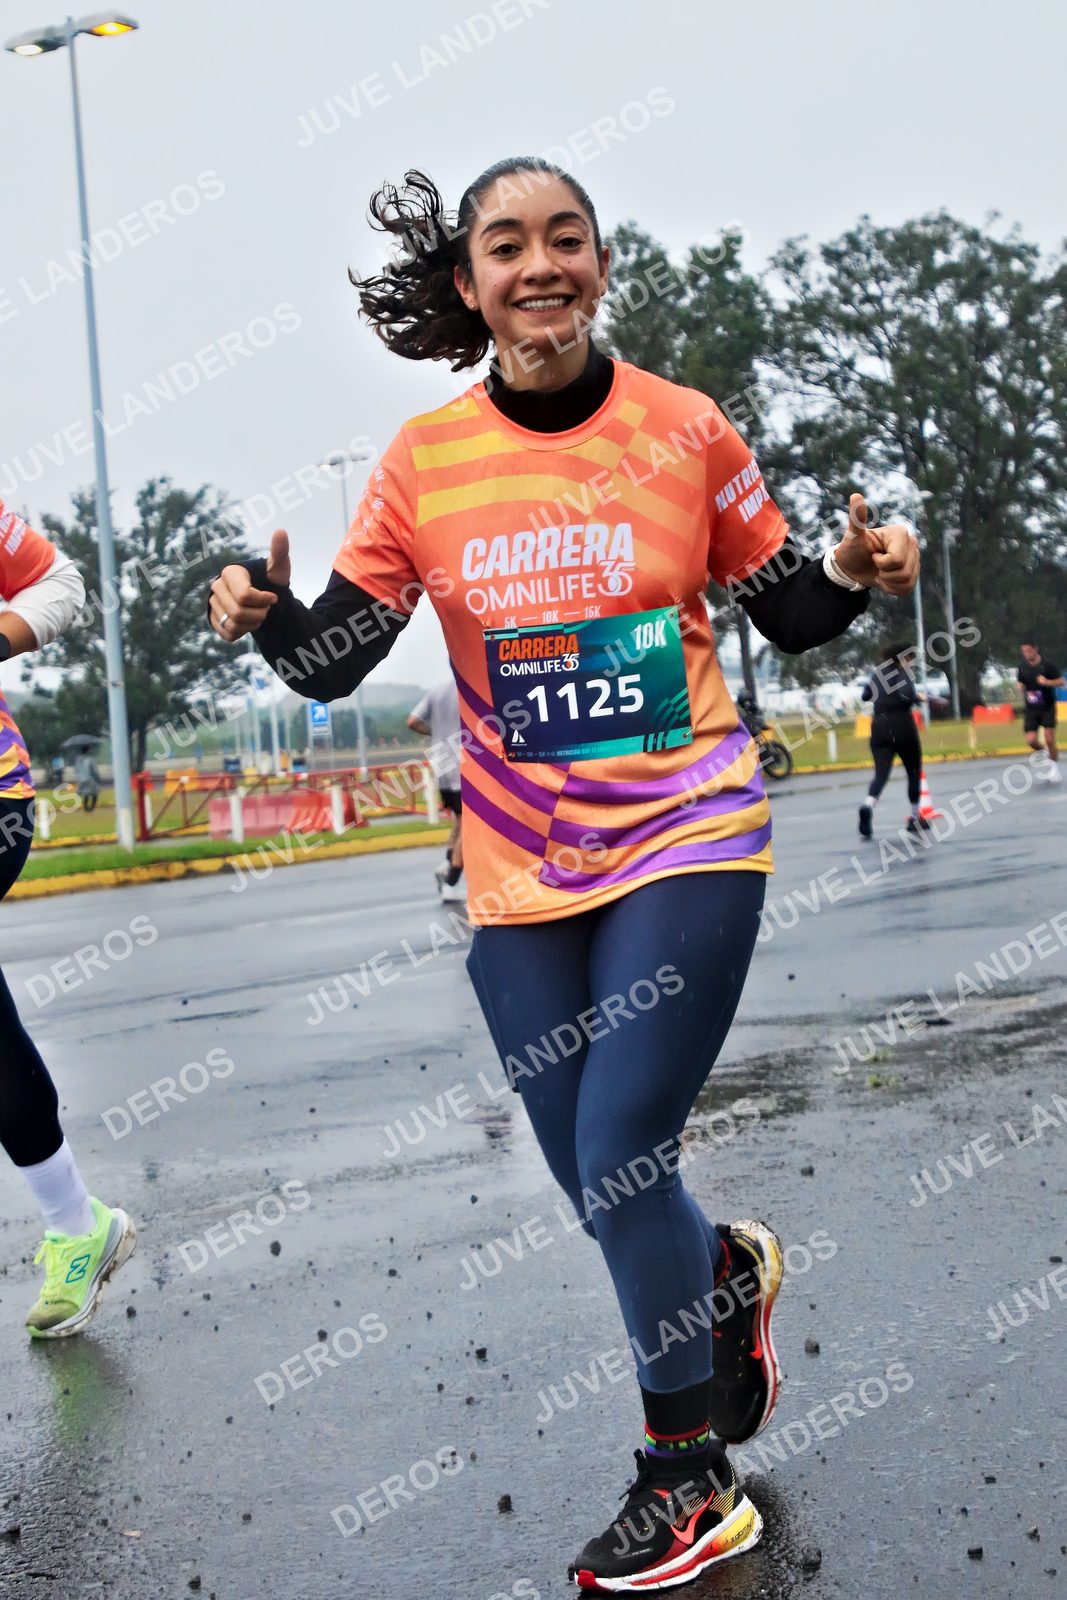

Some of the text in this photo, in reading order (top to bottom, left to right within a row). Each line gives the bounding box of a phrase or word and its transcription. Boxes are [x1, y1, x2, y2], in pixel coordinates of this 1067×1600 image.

[462, 523, 635, 581] CARRERA
[465, 573, 597, 615] OMNILIFE
[542, 610, 559, 623] 10K
[498, 634, 579, 661] CARRERA
[633, 620, 667, 650] 10K
[499, 660, 562, 677] OMNILIFE
[526, 673, 645, 723] 1125
